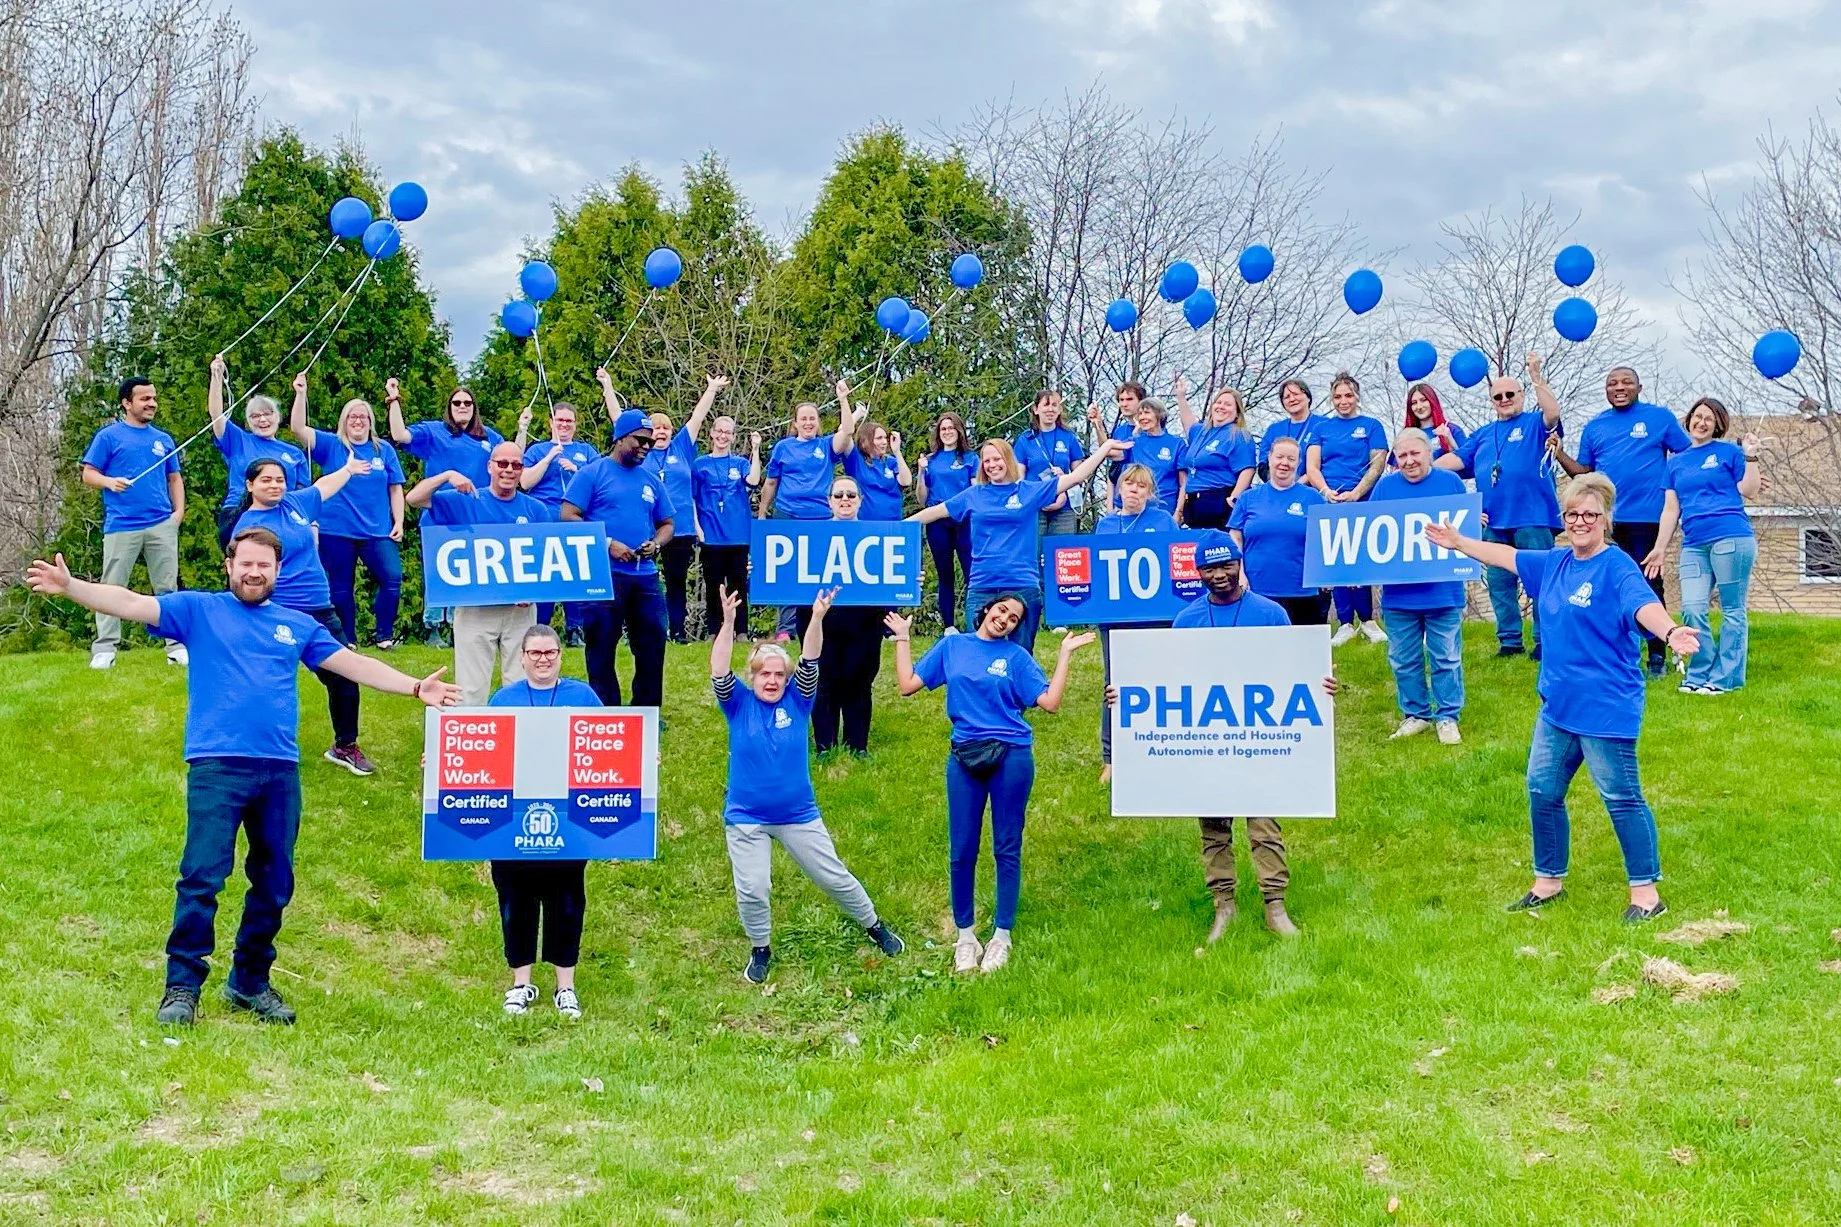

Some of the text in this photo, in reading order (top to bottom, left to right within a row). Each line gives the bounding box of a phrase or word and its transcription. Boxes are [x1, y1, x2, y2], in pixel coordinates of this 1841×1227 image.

[1058, 551, 1082, 559] Great
[1204, 546, 1230, 557] PHARA
[436, 535, 596, 586] GREAT
[765, 534, 906, 584] PLACE
[1059, 559, 1082, 567] Place
[1058, 567, 1068, 575] To
[1099, 548, 1161, 600] TO
[1059, 585, 1089, 593] Certified
[1120, 683, 1324, 728] PHARA
[444, 719, 497, 735] Great
[573, 719, 625, 735] Great
[445, 736, 496, 751] Place
[574, 736, 624, 751] Place
[1134, 730, 1301, 743] Independence and Housing
[1148, 746, 1292, 758] Autonomie et logement
[444, 753, 465, 768] To
[574, 753, 593, 767] To
[442, 795, 508, 809] Certified
[576, 794, 632, 808] Certifié
[459, 817, 490, 825] CANADA
[529, 813, 552, 835] 50
[514, 836, 565, 848] PHARA
